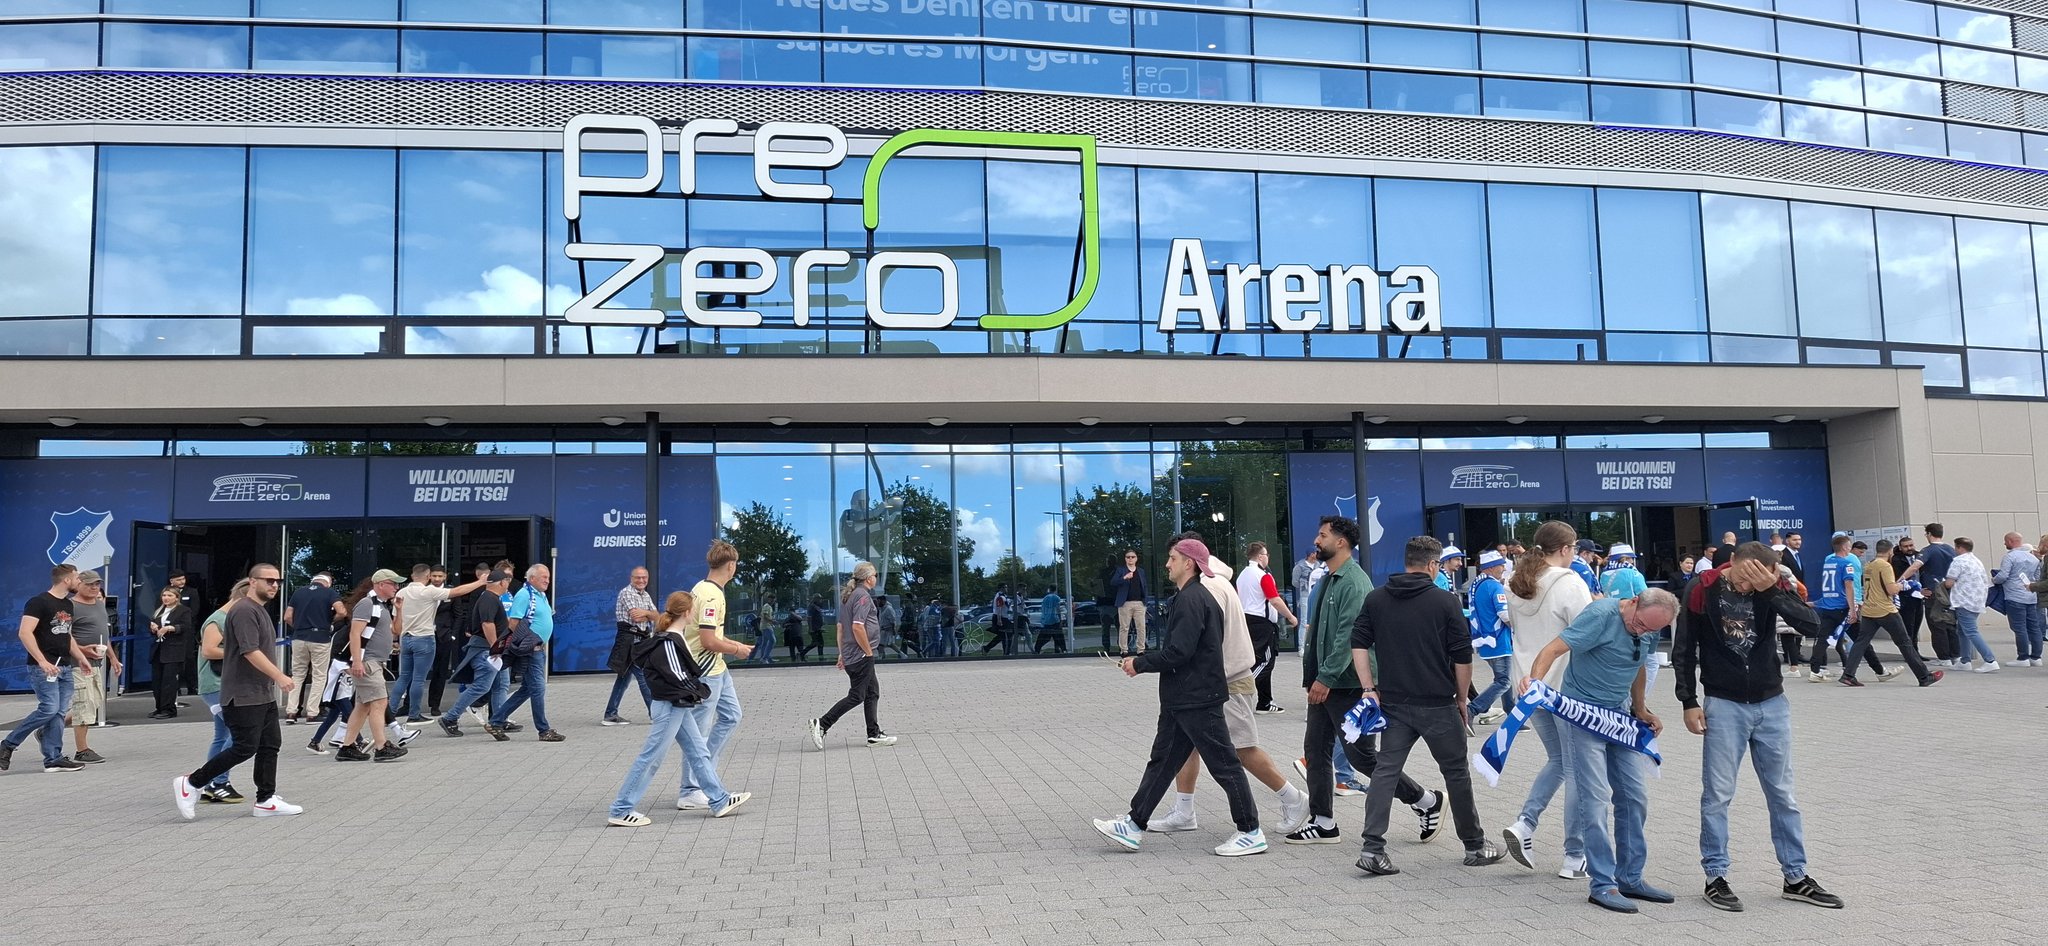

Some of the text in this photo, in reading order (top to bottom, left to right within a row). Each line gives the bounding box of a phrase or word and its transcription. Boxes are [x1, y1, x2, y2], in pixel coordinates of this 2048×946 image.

[776, 0, 889, 13] ues
[563, 113, 849, 221] pre
[563, 237, 1442, 334] zero Arena
[1596, 461, 1676, 475] WILLKOMMEN
[409, 468, 515, 485] WILLKOMMEN
[1485, 473, 1503, 482] pre
[1601, 476, 1673, 490] BEI DER TSG!
[257, 483, 282, 493] pre
[1486, 480, 1540, 489] zero Arena
[257, 491, 331, 501] zero Arena
[413, 486, 509, 503] BEI DER TSG!
[61, 525, 92, 556] TSG 1899
[1822, 570, 1837, 592] 27
